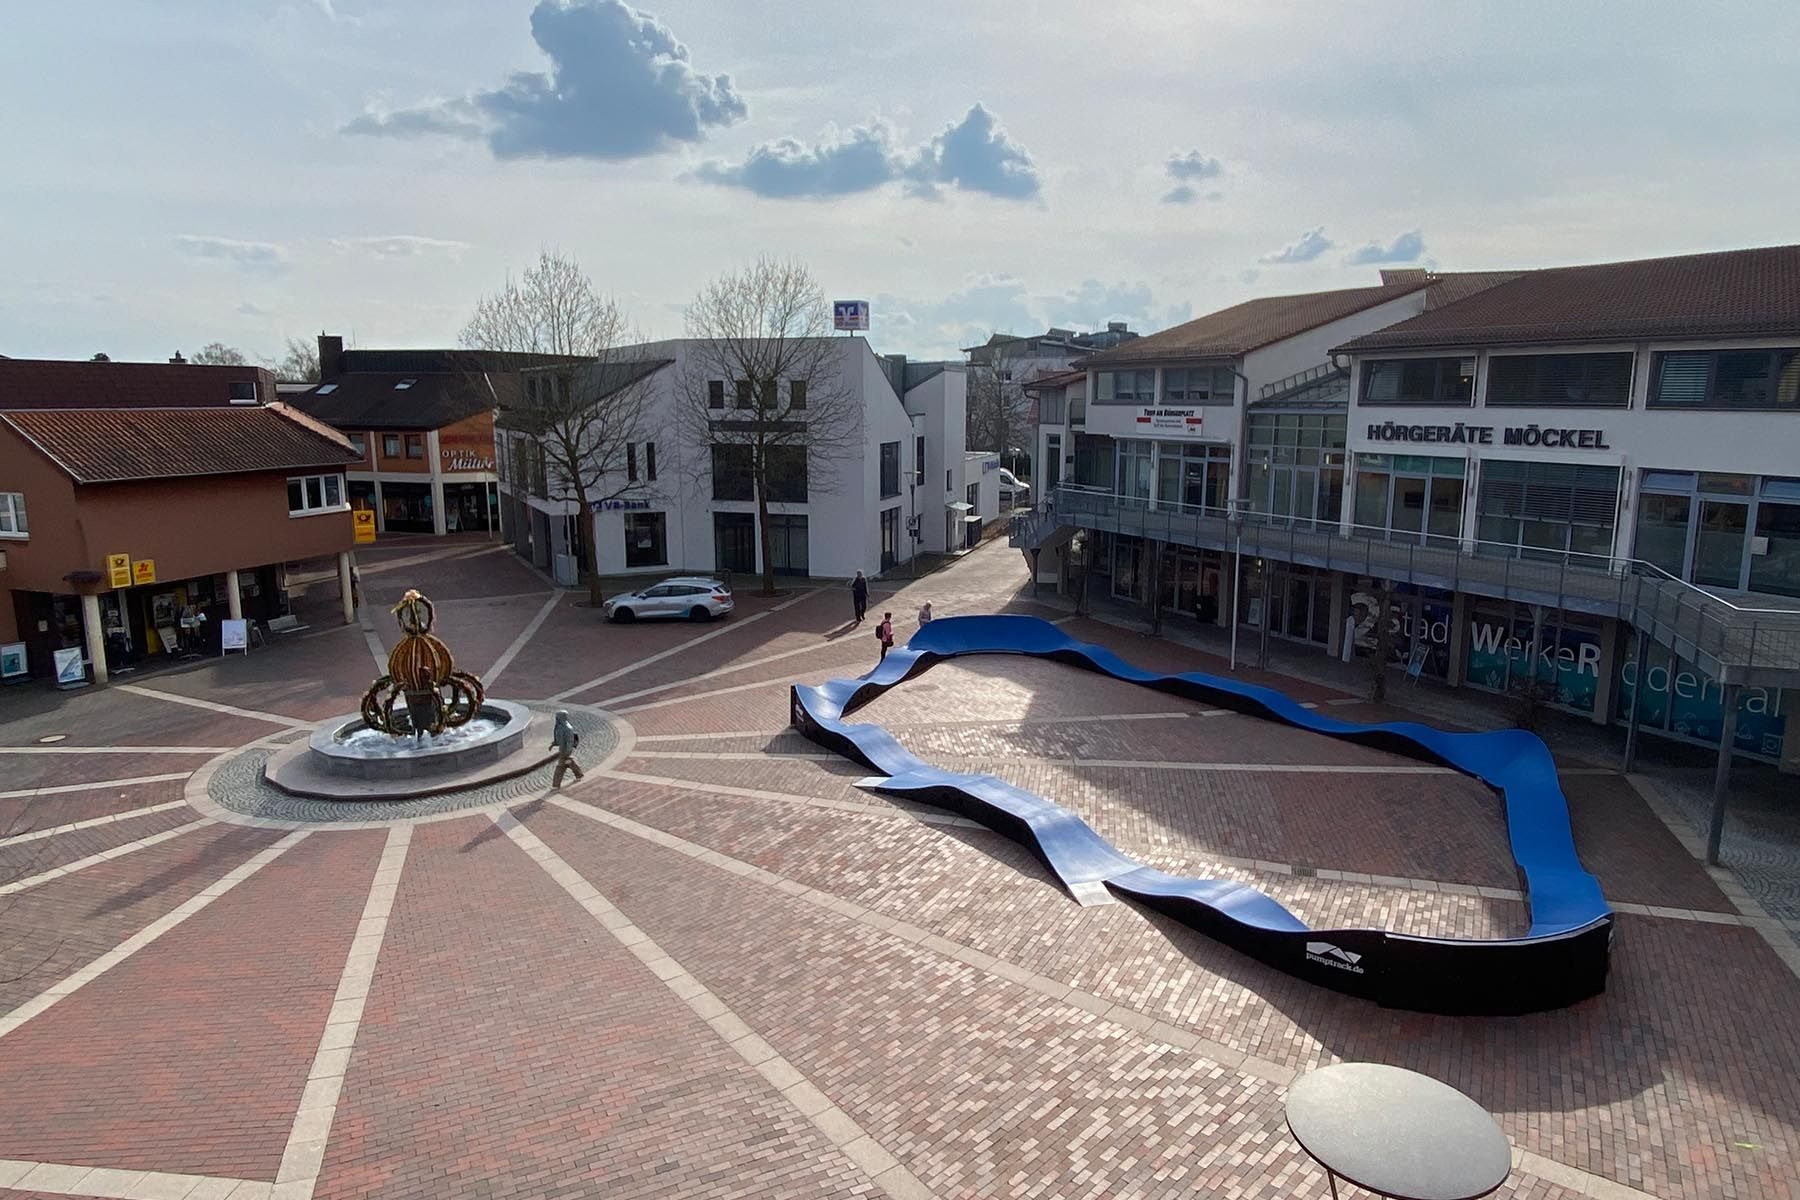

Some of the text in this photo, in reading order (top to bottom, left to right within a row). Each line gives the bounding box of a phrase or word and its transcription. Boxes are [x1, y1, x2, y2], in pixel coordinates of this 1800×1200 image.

[1367, 421, 1610, 449] HÖRGERÄTE MÖCKEL
[441, 449, 476, 458] OPTIK
[1306, 952, 1365, 974] pumptrack.de
